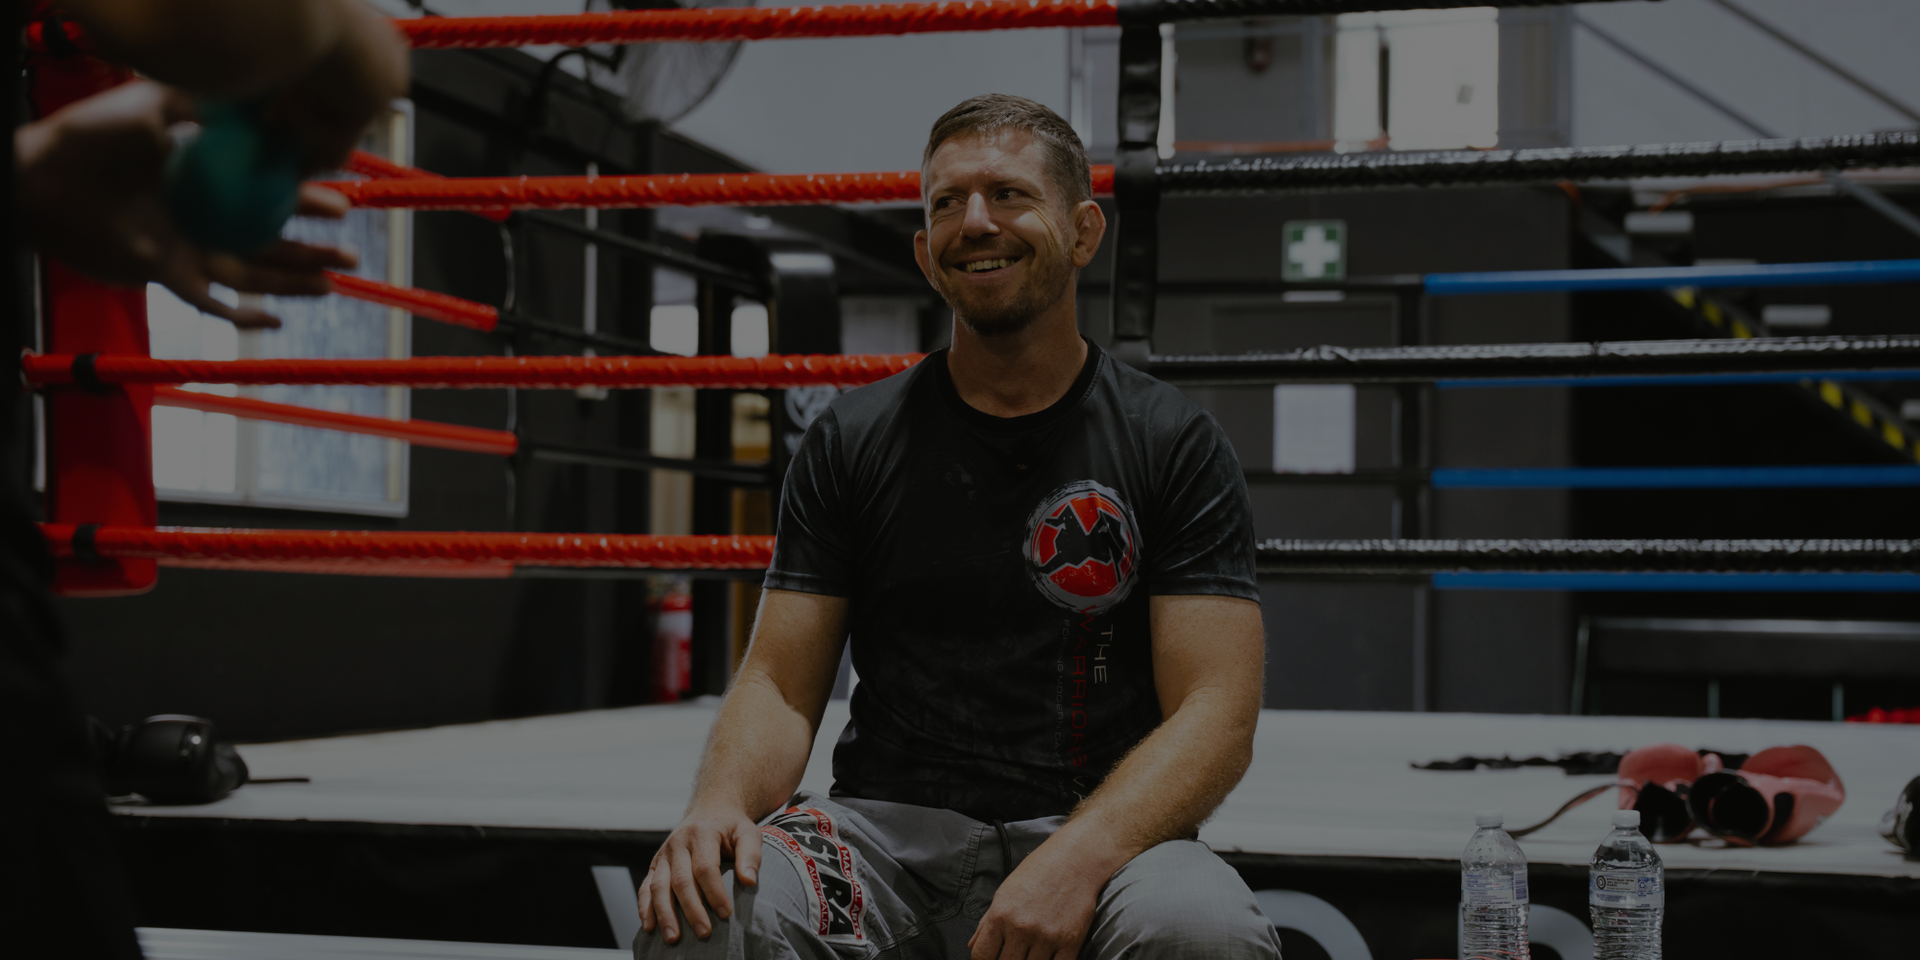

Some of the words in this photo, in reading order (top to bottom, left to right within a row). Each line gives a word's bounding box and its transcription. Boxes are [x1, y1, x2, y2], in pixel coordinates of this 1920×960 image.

[1070, 604, 1097, 767] WARRIORS
[1094, 624, 1114, 684] THE
[1055, 675, 1064, 729] MODERN
[808, 863, 829, 932] AUSTRALIA
